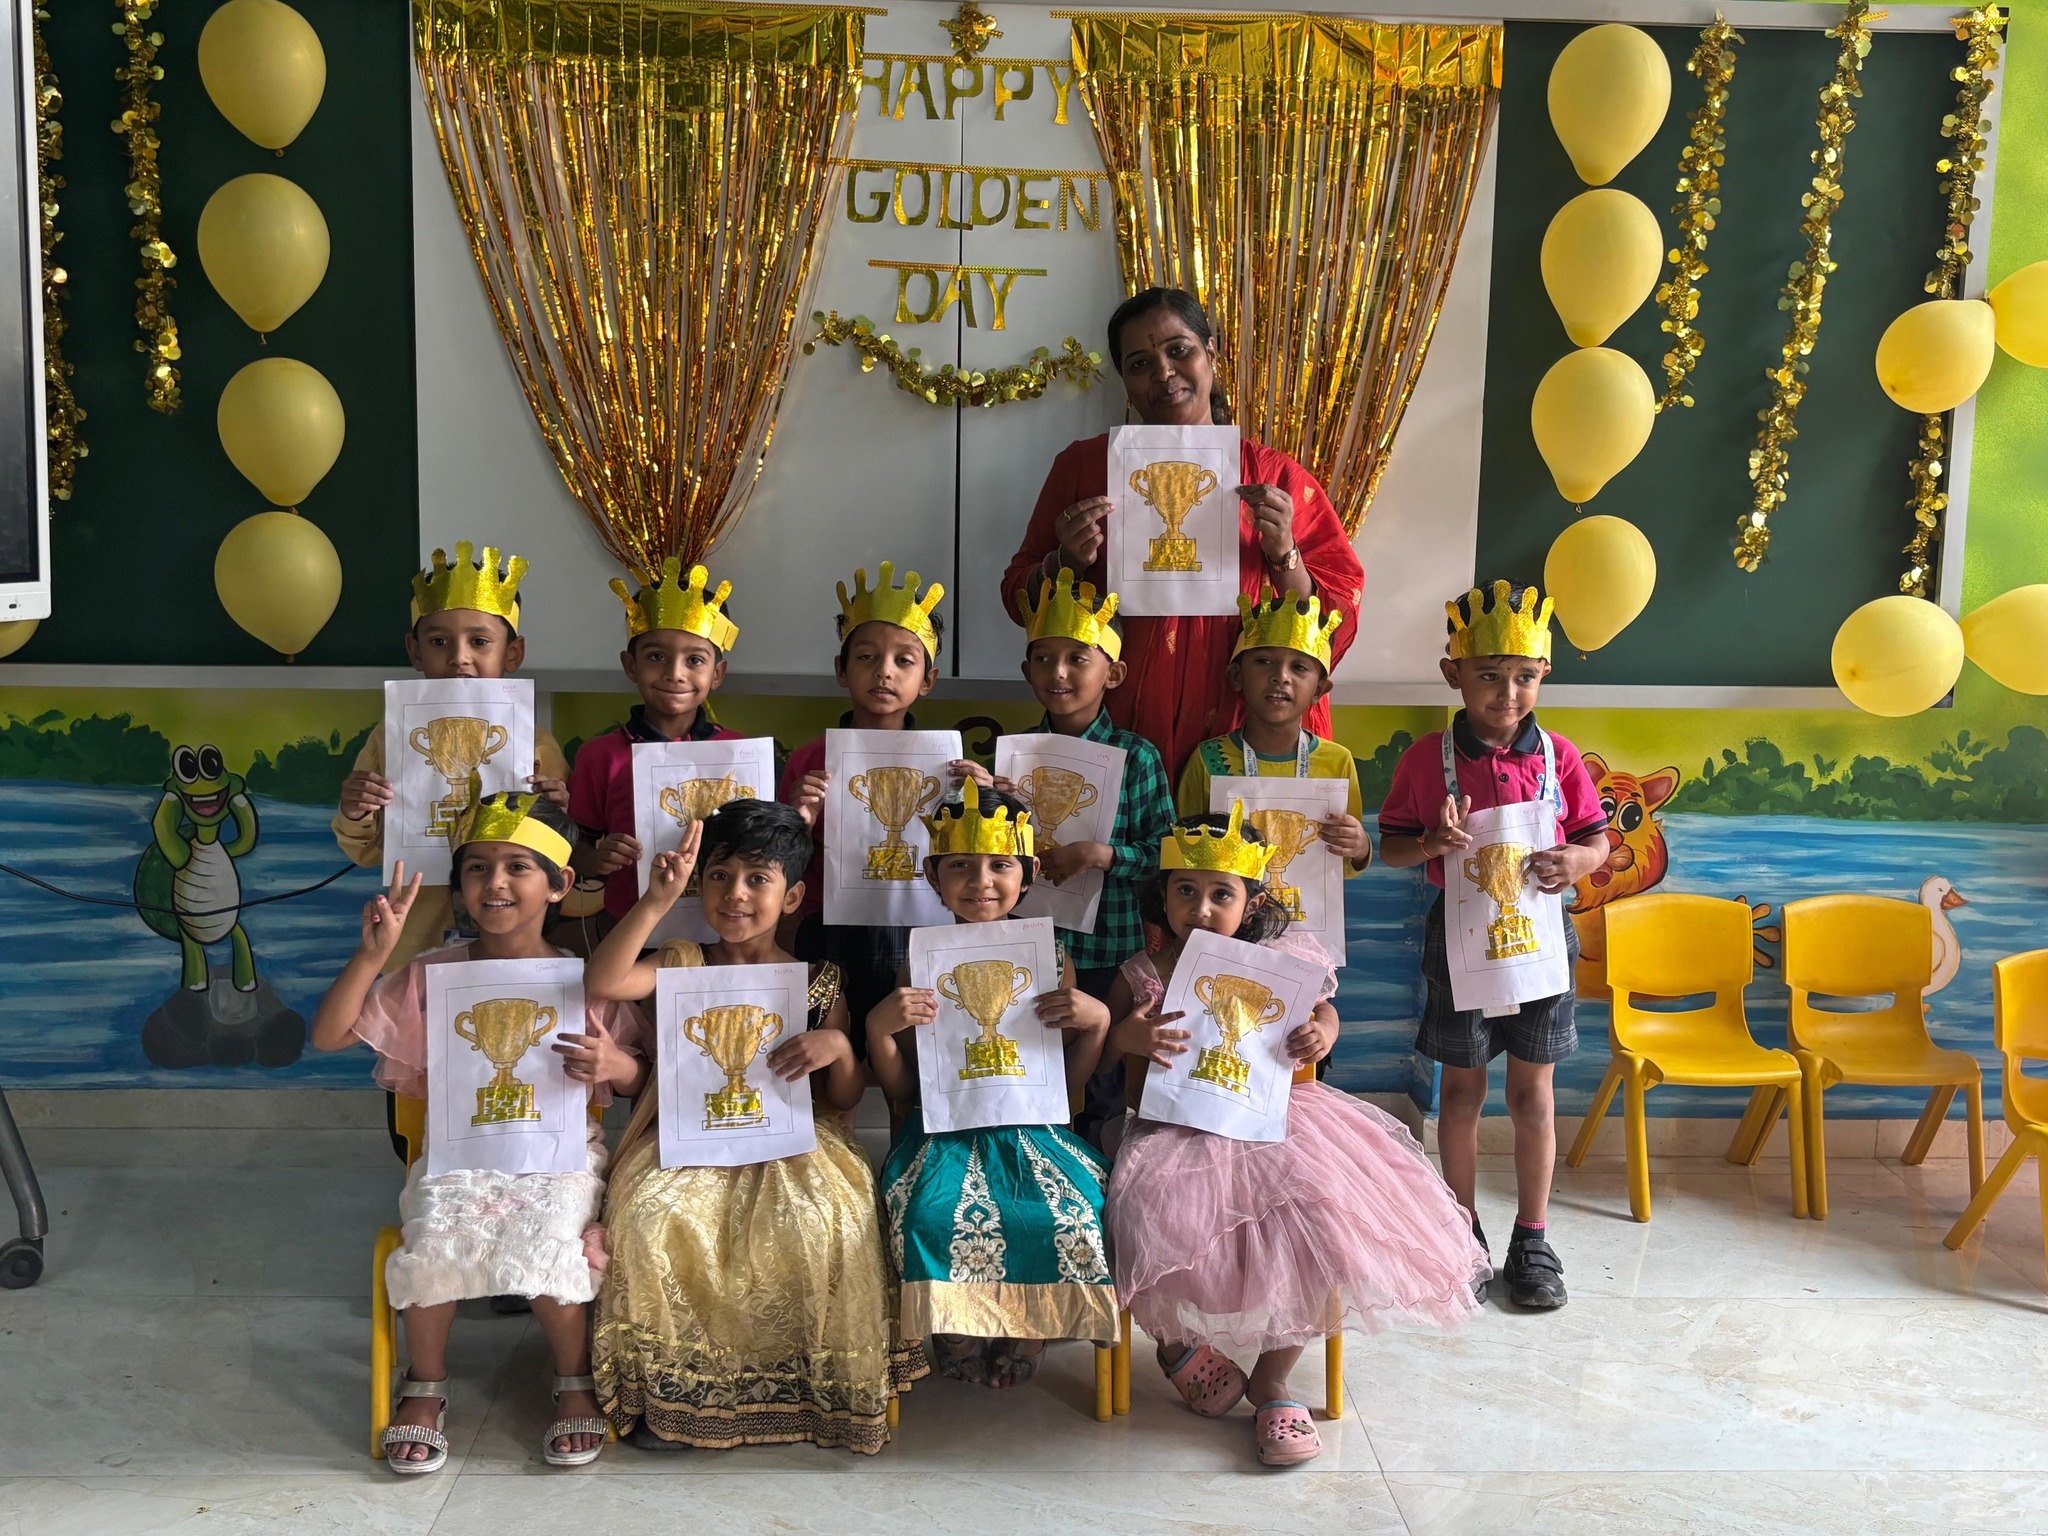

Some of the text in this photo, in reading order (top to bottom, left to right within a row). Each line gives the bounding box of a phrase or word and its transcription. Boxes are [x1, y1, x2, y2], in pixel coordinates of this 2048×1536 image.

[845, 59, 1075, 126] HAPPY
[846, 166, 1101, 232] GOLDEN
[895, 267, 1018, 331] DAY
